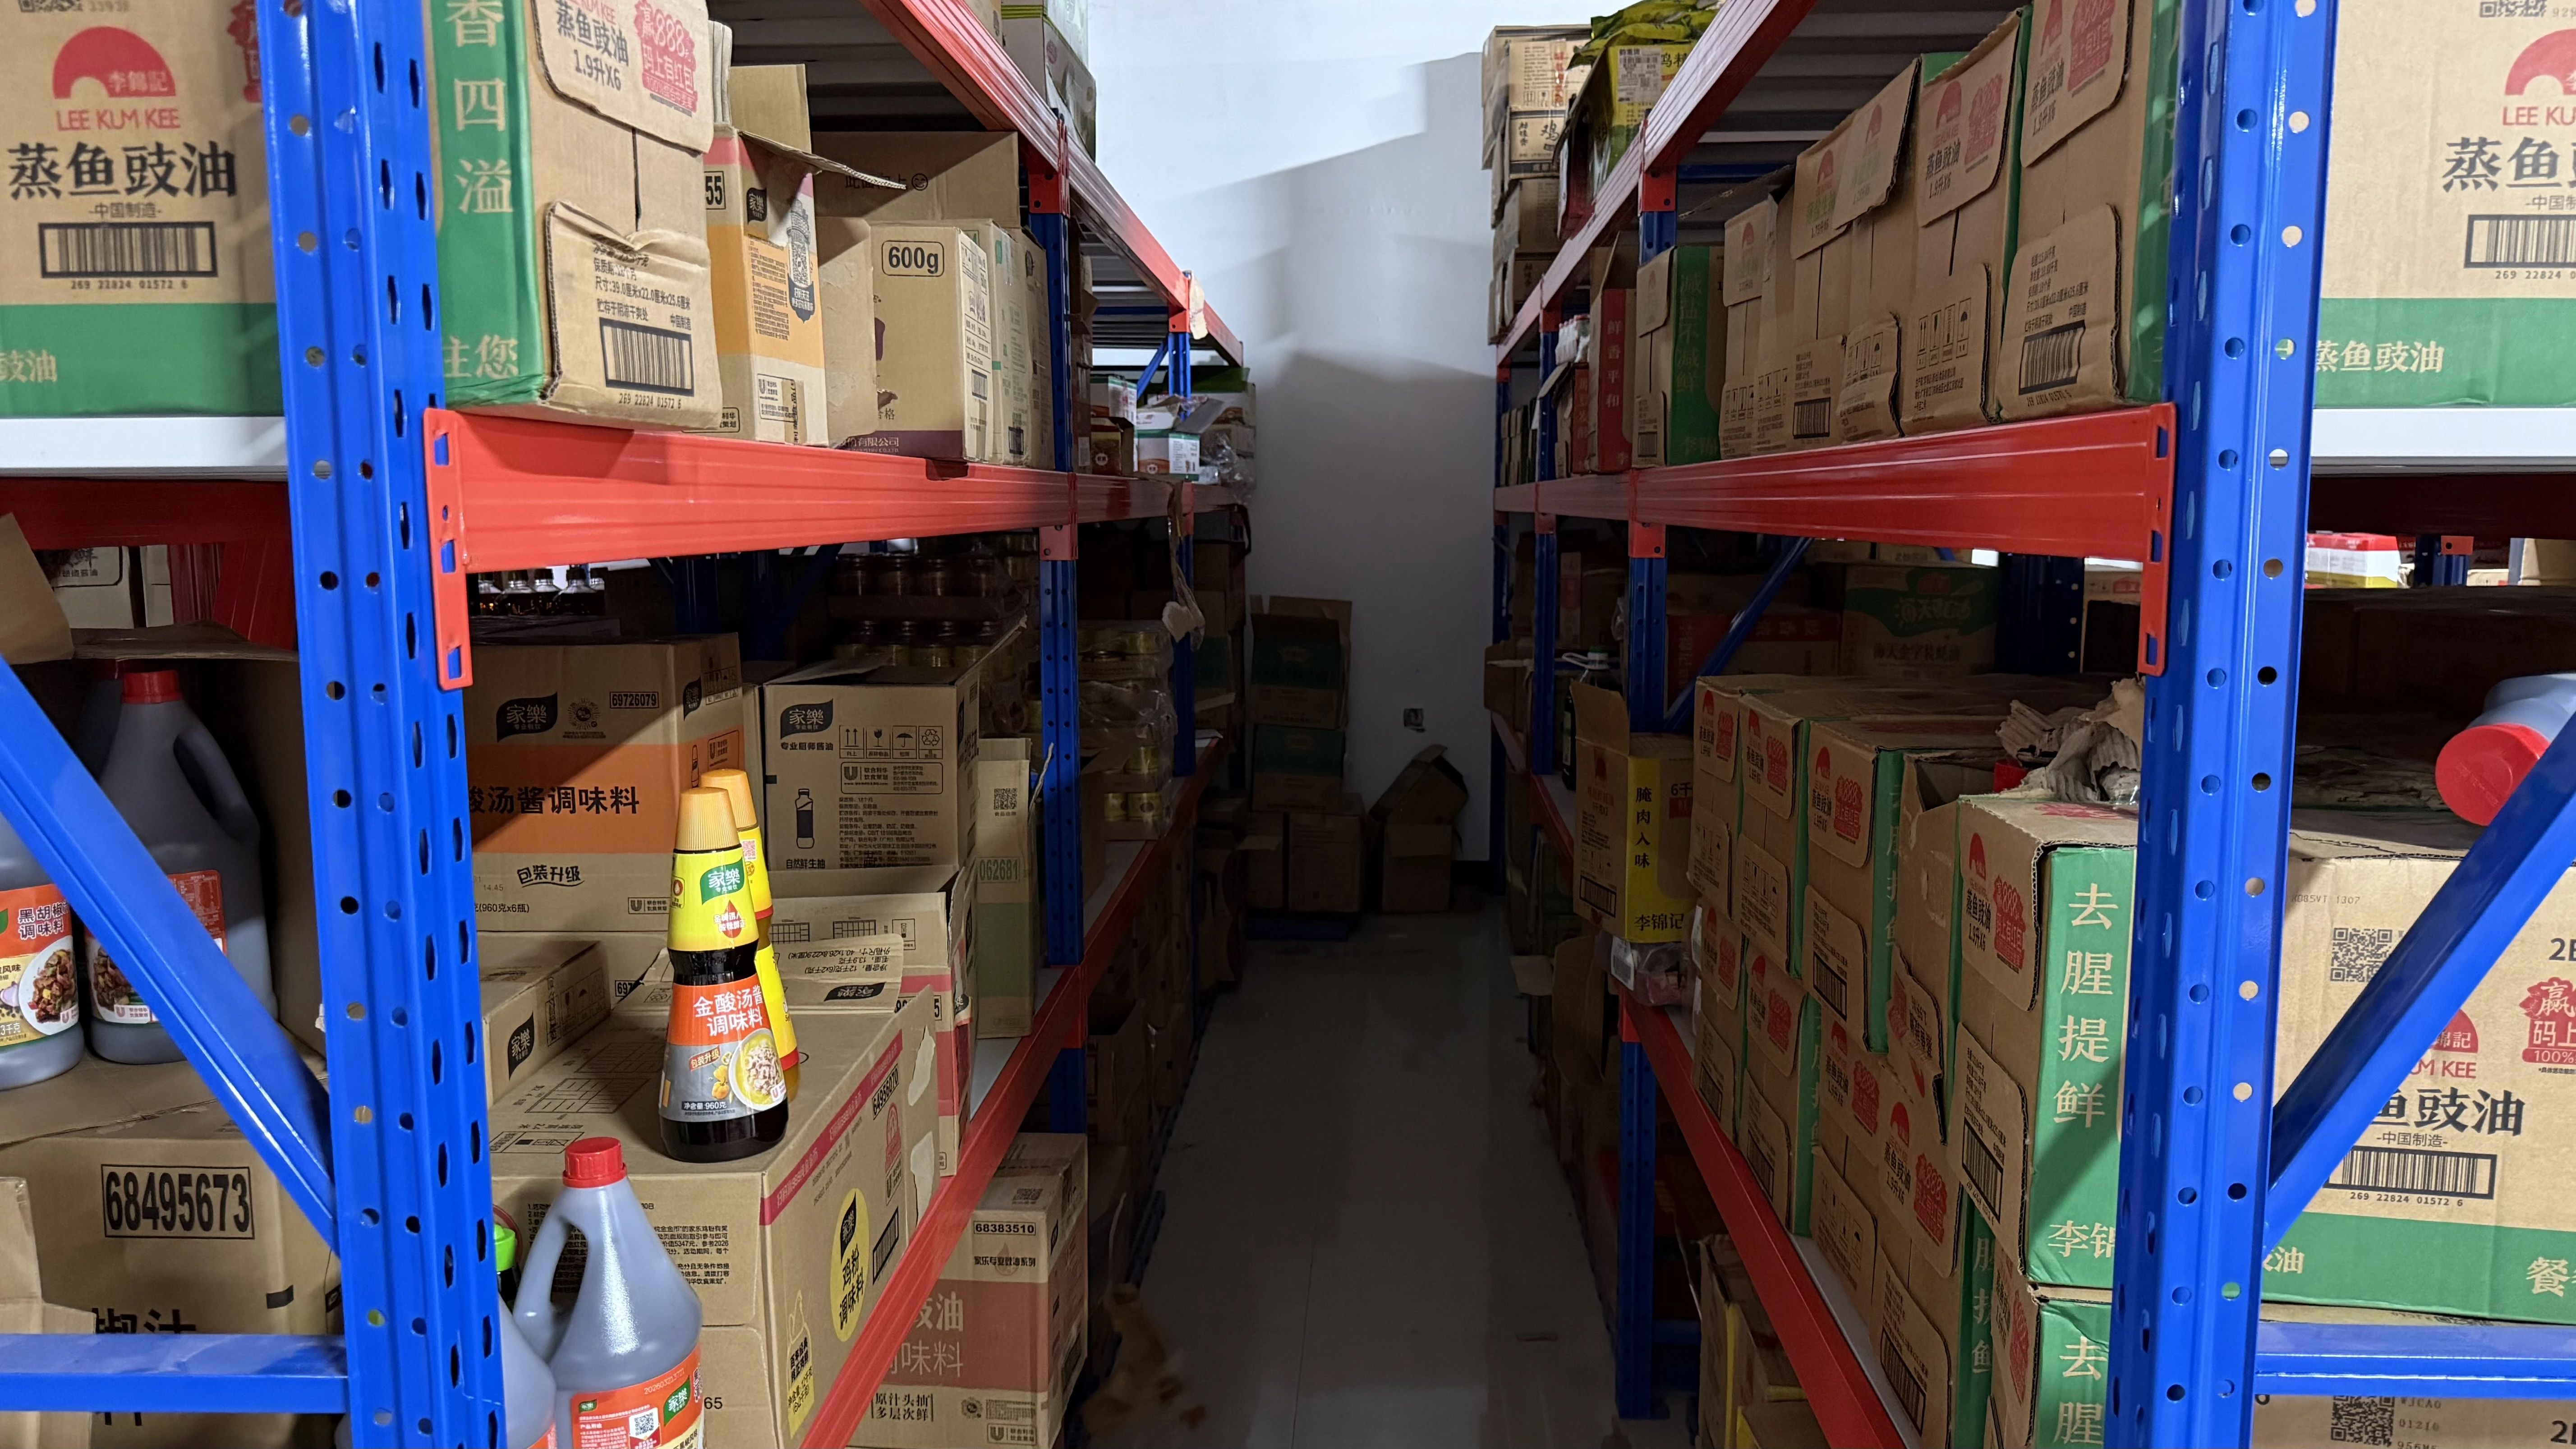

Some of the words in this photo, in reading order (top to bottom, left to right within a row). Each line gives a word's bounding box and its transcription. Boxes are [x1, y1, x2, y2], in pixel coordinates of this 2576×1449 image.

[56, 109, 89, 131] LEE
[97, 108, 139, 130] KUM
[146, 108, 181, 129] KEE
[2502, 106, 2539, 126] LEE
[7, 141, 237, 201] 蒸鱼豉油
[2442, 137, 2576, 192] 蒸鱼
[888, 246, 939, 274] 600g
[71, 279, 90, 290] 269
[98, 279, 131, 290] 22824
[139, 279, 174, 290] 01572
[181, 279, 188, 290] 6
[2495, 270, 2517, 280] 269
[2525, 270, 2562, 280] 22824
[2316, 340, 2444, 373] 蒸鱼豉油
[619, 393, 631, 404] 269
[635, 394, 654, 407] 22824
[657, 396, 675, 409] 01572
[612, 694, 657, 707] 69726079
[506, 704, 547, 724] 家樂
[788, 708, 824, 726] 家樂
[781, 742, 833, 751] 专业厨师酱油
[1634, 787, 1652, 869] 腌肉入味
[786, 859, 826, 869] 自然鲜生抽
[516, 865, 581, 885] 包装升级
[708, 868, 741, 889] 家樂
[18, 918, 64, 940] 调味料
[1634, 913, 1684, 932] 李锦记
[694, 984, 764, 1018] 金酸汤酱
[2053, 883, 2118, 1128] 去腥提鲜
[707, 1006, 763, 1037] 调味料
[690, 1048, 721, 1068] 包装升级
[2442, 1061, 2477, 1079] KEE
[105, 1171, 250, 1233] 68495673
[2350, 1191, 2370, 1201] 269
[2377, 1192, 2410, 1203] 22824
[2417, 1196, 2450, 1207] 01572
[2457, 1198, 2464, 1208] 6
[975, 1223, 1035, 1233] 68383510
[843, 1243, 860, 1292] 鸡粉
[839, 1266, 864, 1331] 调味料
[886, 1339, 964, 1377] 味料
[875, 1393, 930, 1407] 原汁头抽
[2053, 1335, 2108, 1445] 去腥
[704, 1397, 723, 1410] 65
[876, 1407, 929, 1421] 多层次鲜
